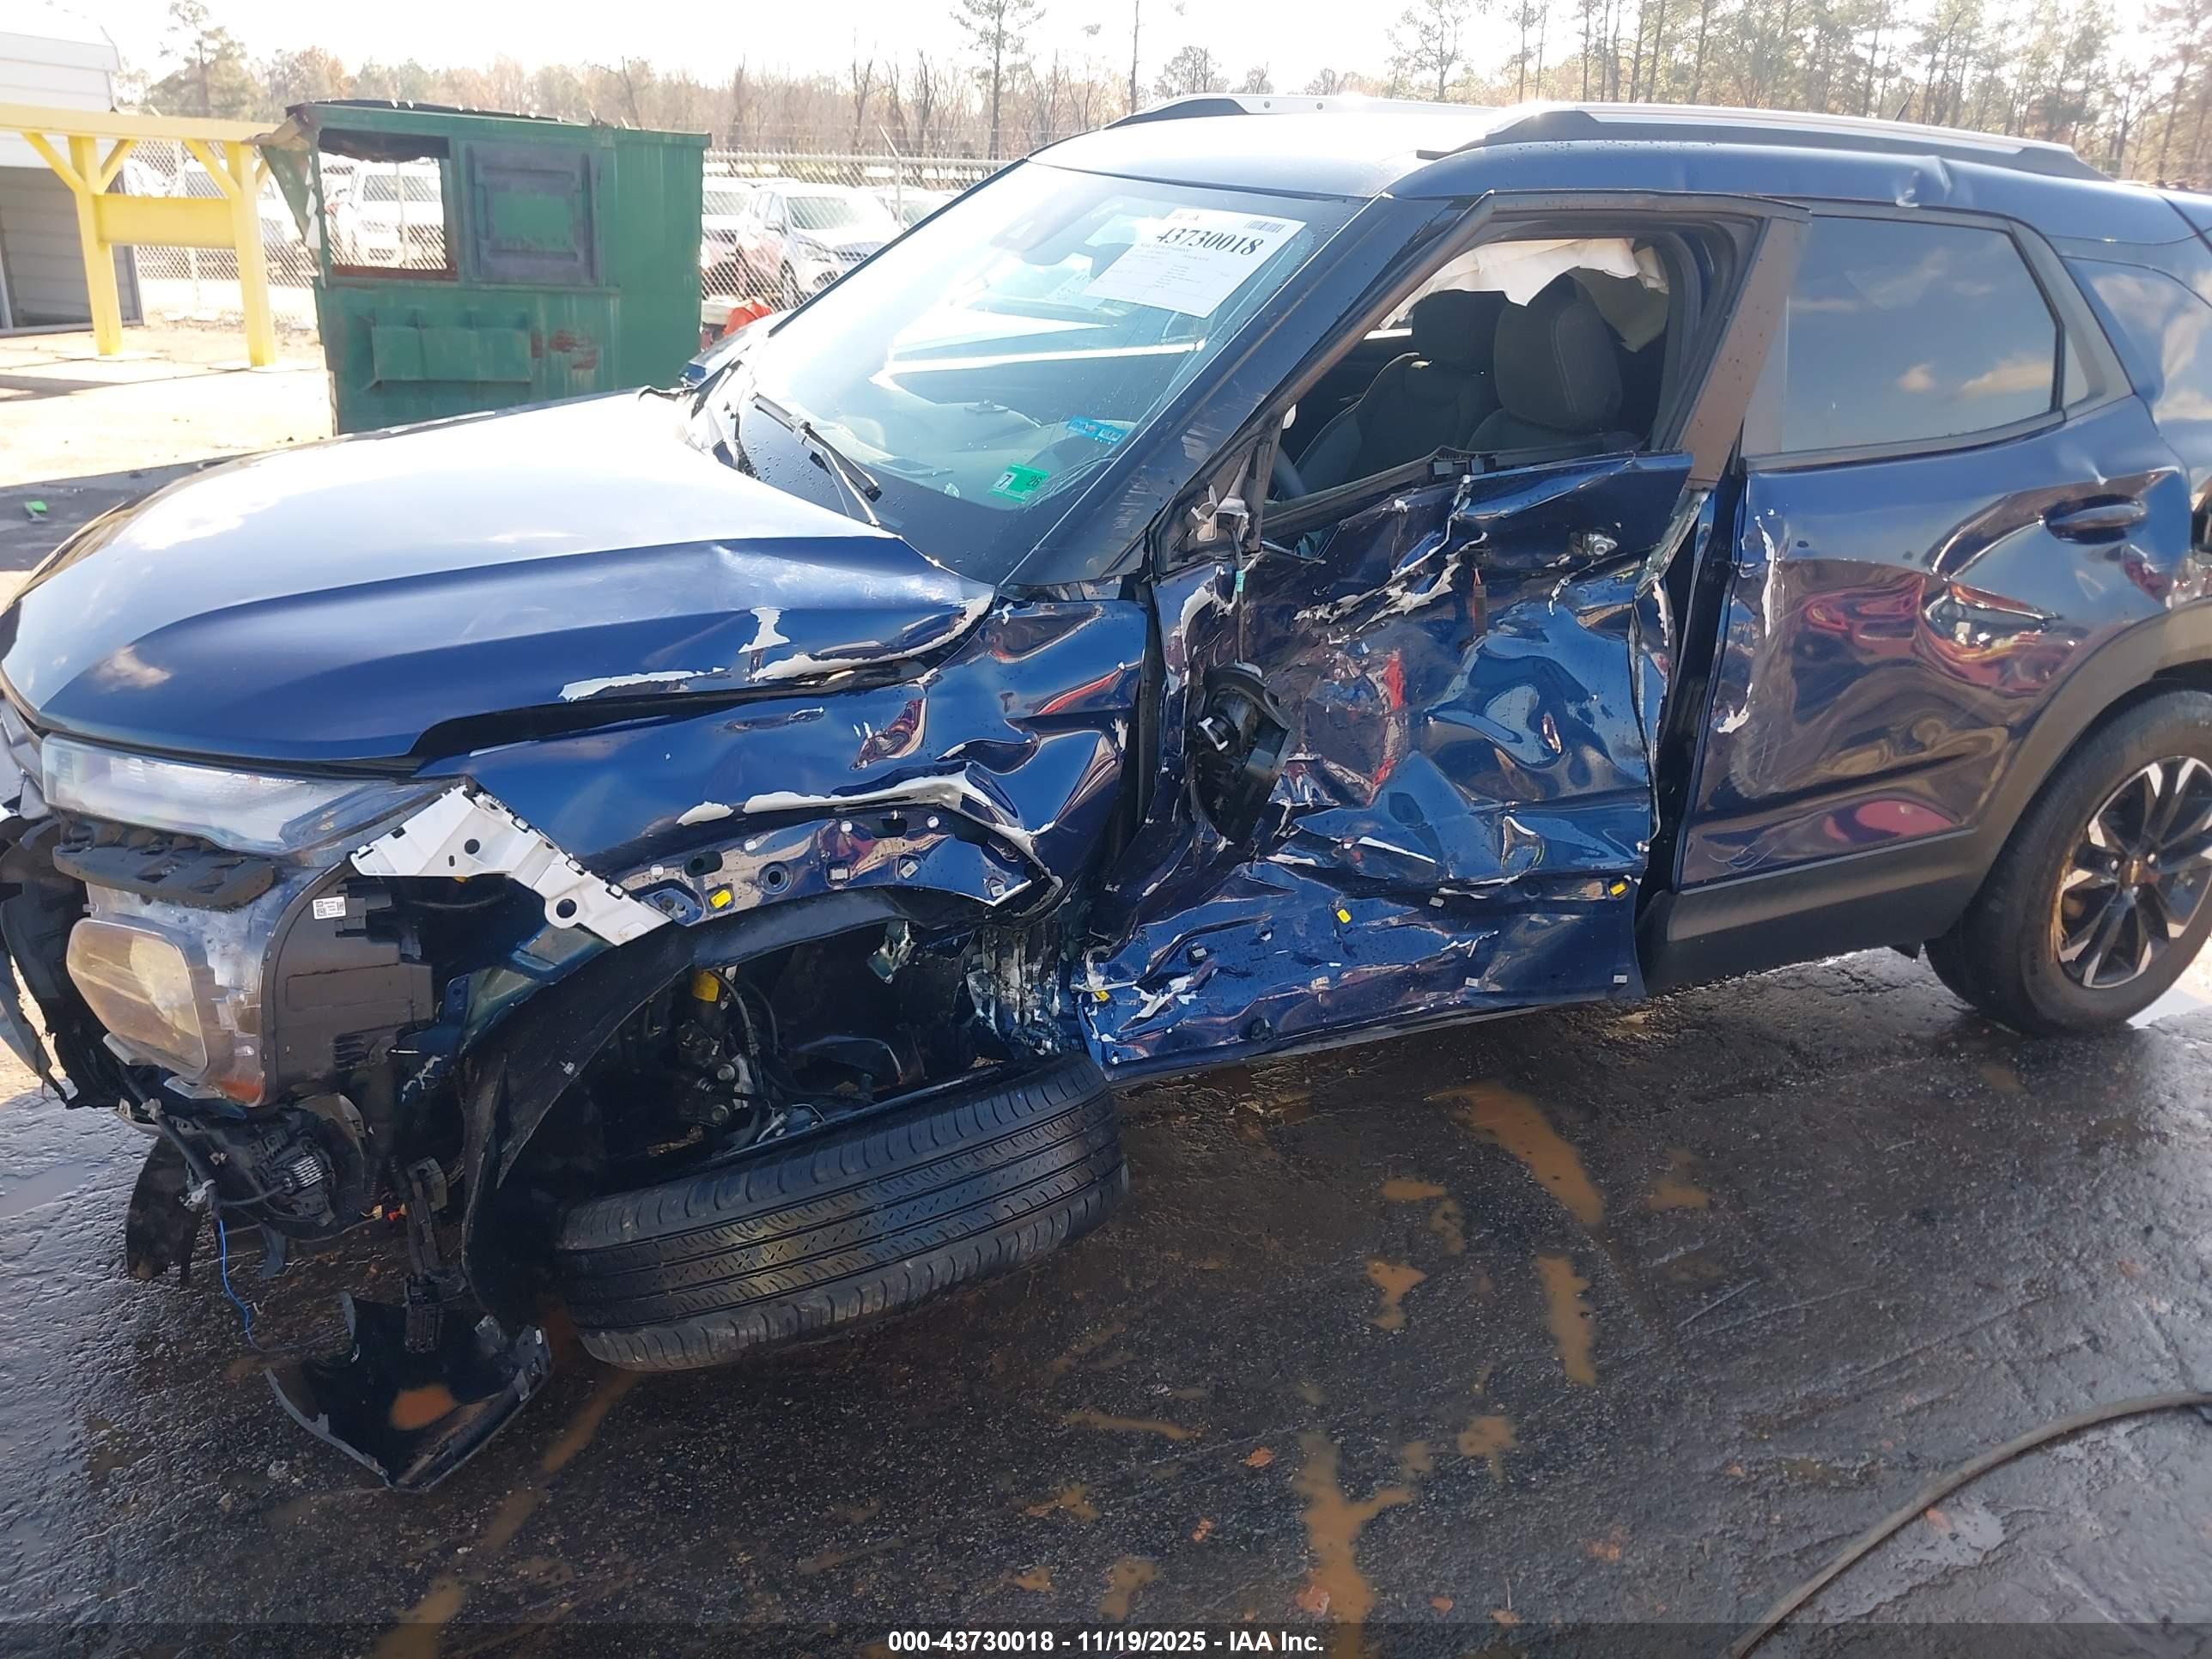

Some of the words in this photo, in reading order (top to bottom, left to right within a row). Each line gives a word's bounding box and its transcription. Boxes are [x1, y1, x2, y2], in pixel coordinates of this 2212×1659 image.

[1156, 227, 1265, 256] 43730018
[998, 474, 1012, 488] 7
[1026, 475, 1043, 488] 26
